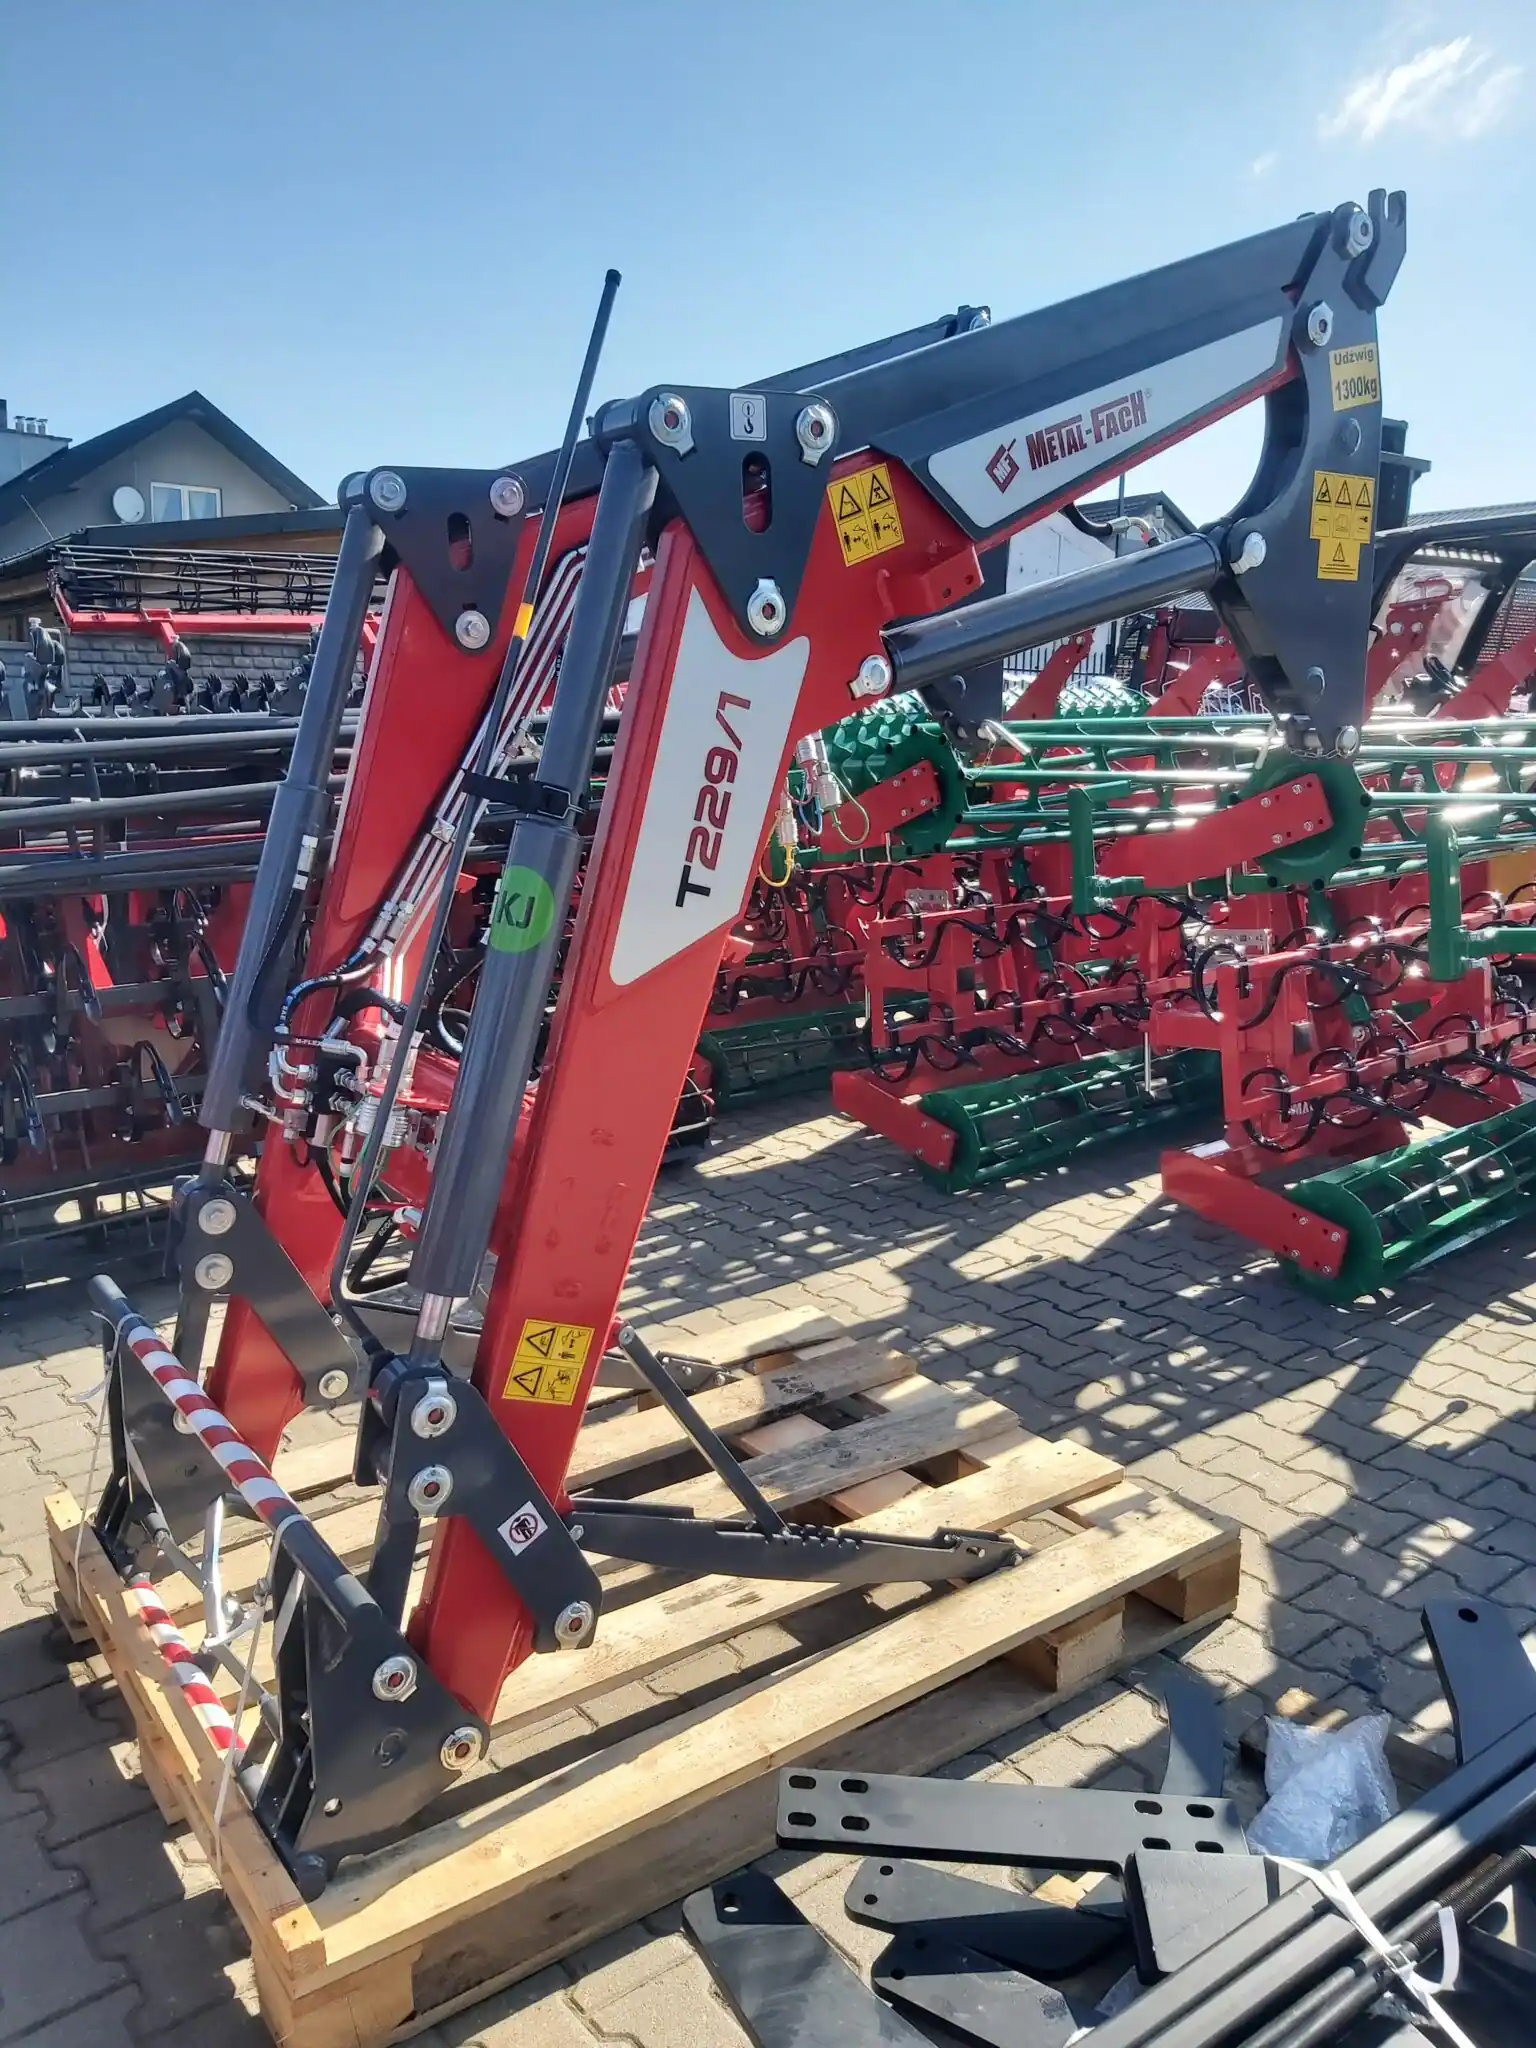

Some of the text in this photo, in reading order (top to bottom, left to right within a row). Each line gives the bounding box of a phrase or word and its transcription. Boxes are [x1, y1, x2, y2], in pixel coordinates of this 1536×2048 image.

[1334, 375, 1378, 401] 1300kg
[675, 691, 751, 908] T229/1
[496, 890, 535, 929] KJ
